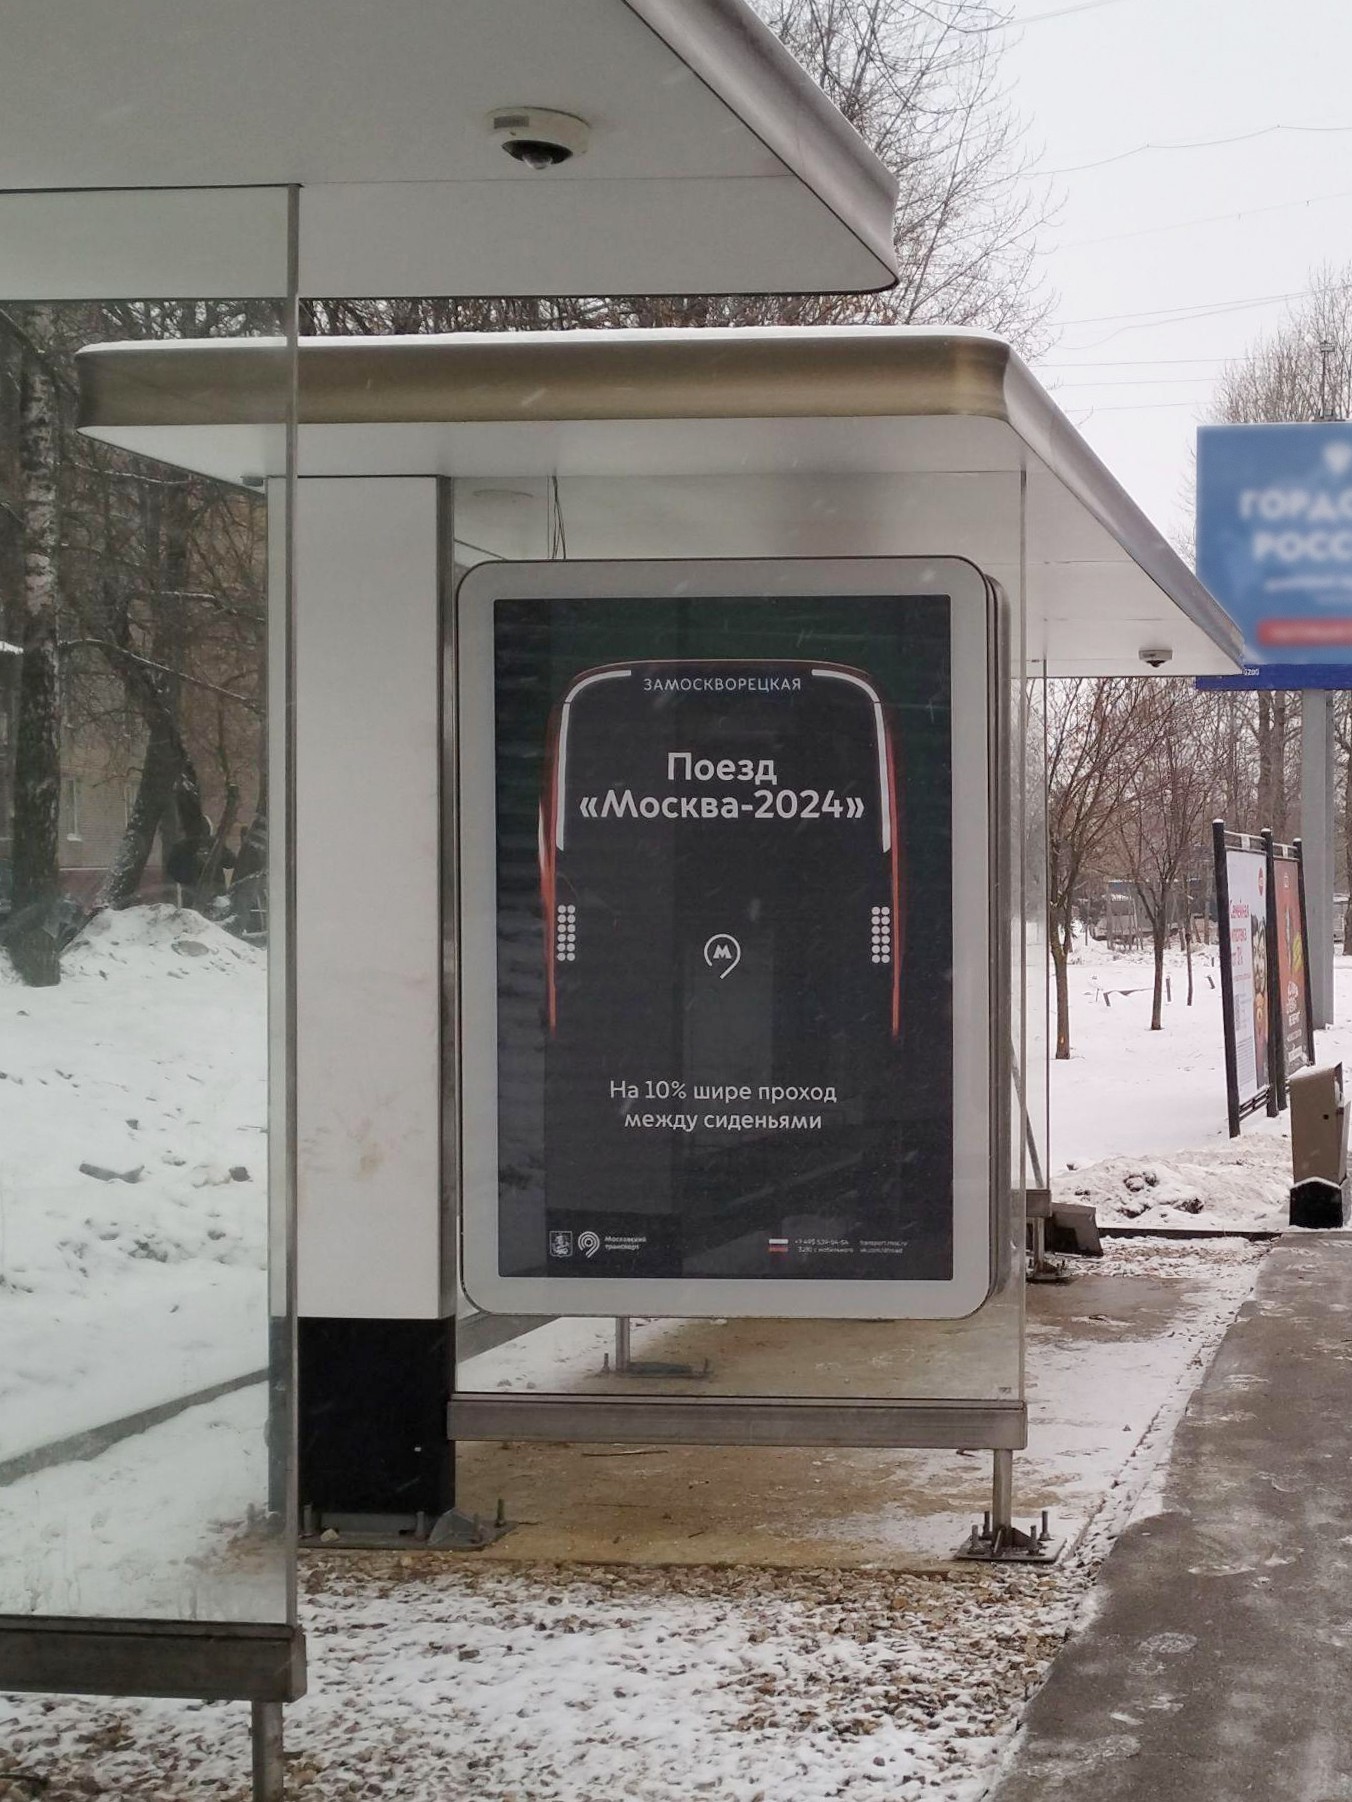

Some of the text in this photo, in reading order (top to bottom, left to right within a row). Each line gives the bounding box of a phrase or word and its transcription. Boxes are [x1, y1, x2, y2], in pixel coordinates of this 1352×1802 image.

[643, 677, 801, 692] ЗАМОСКВОРЕЦКАЯ
[667, 752, 778, 786] Поезд
[579, 789, 865, 819] «Москва-2024»
[610, 1080, 837, 1105] На 10% шире проход
[624, 1113, 822, 1133] между сиденьями
